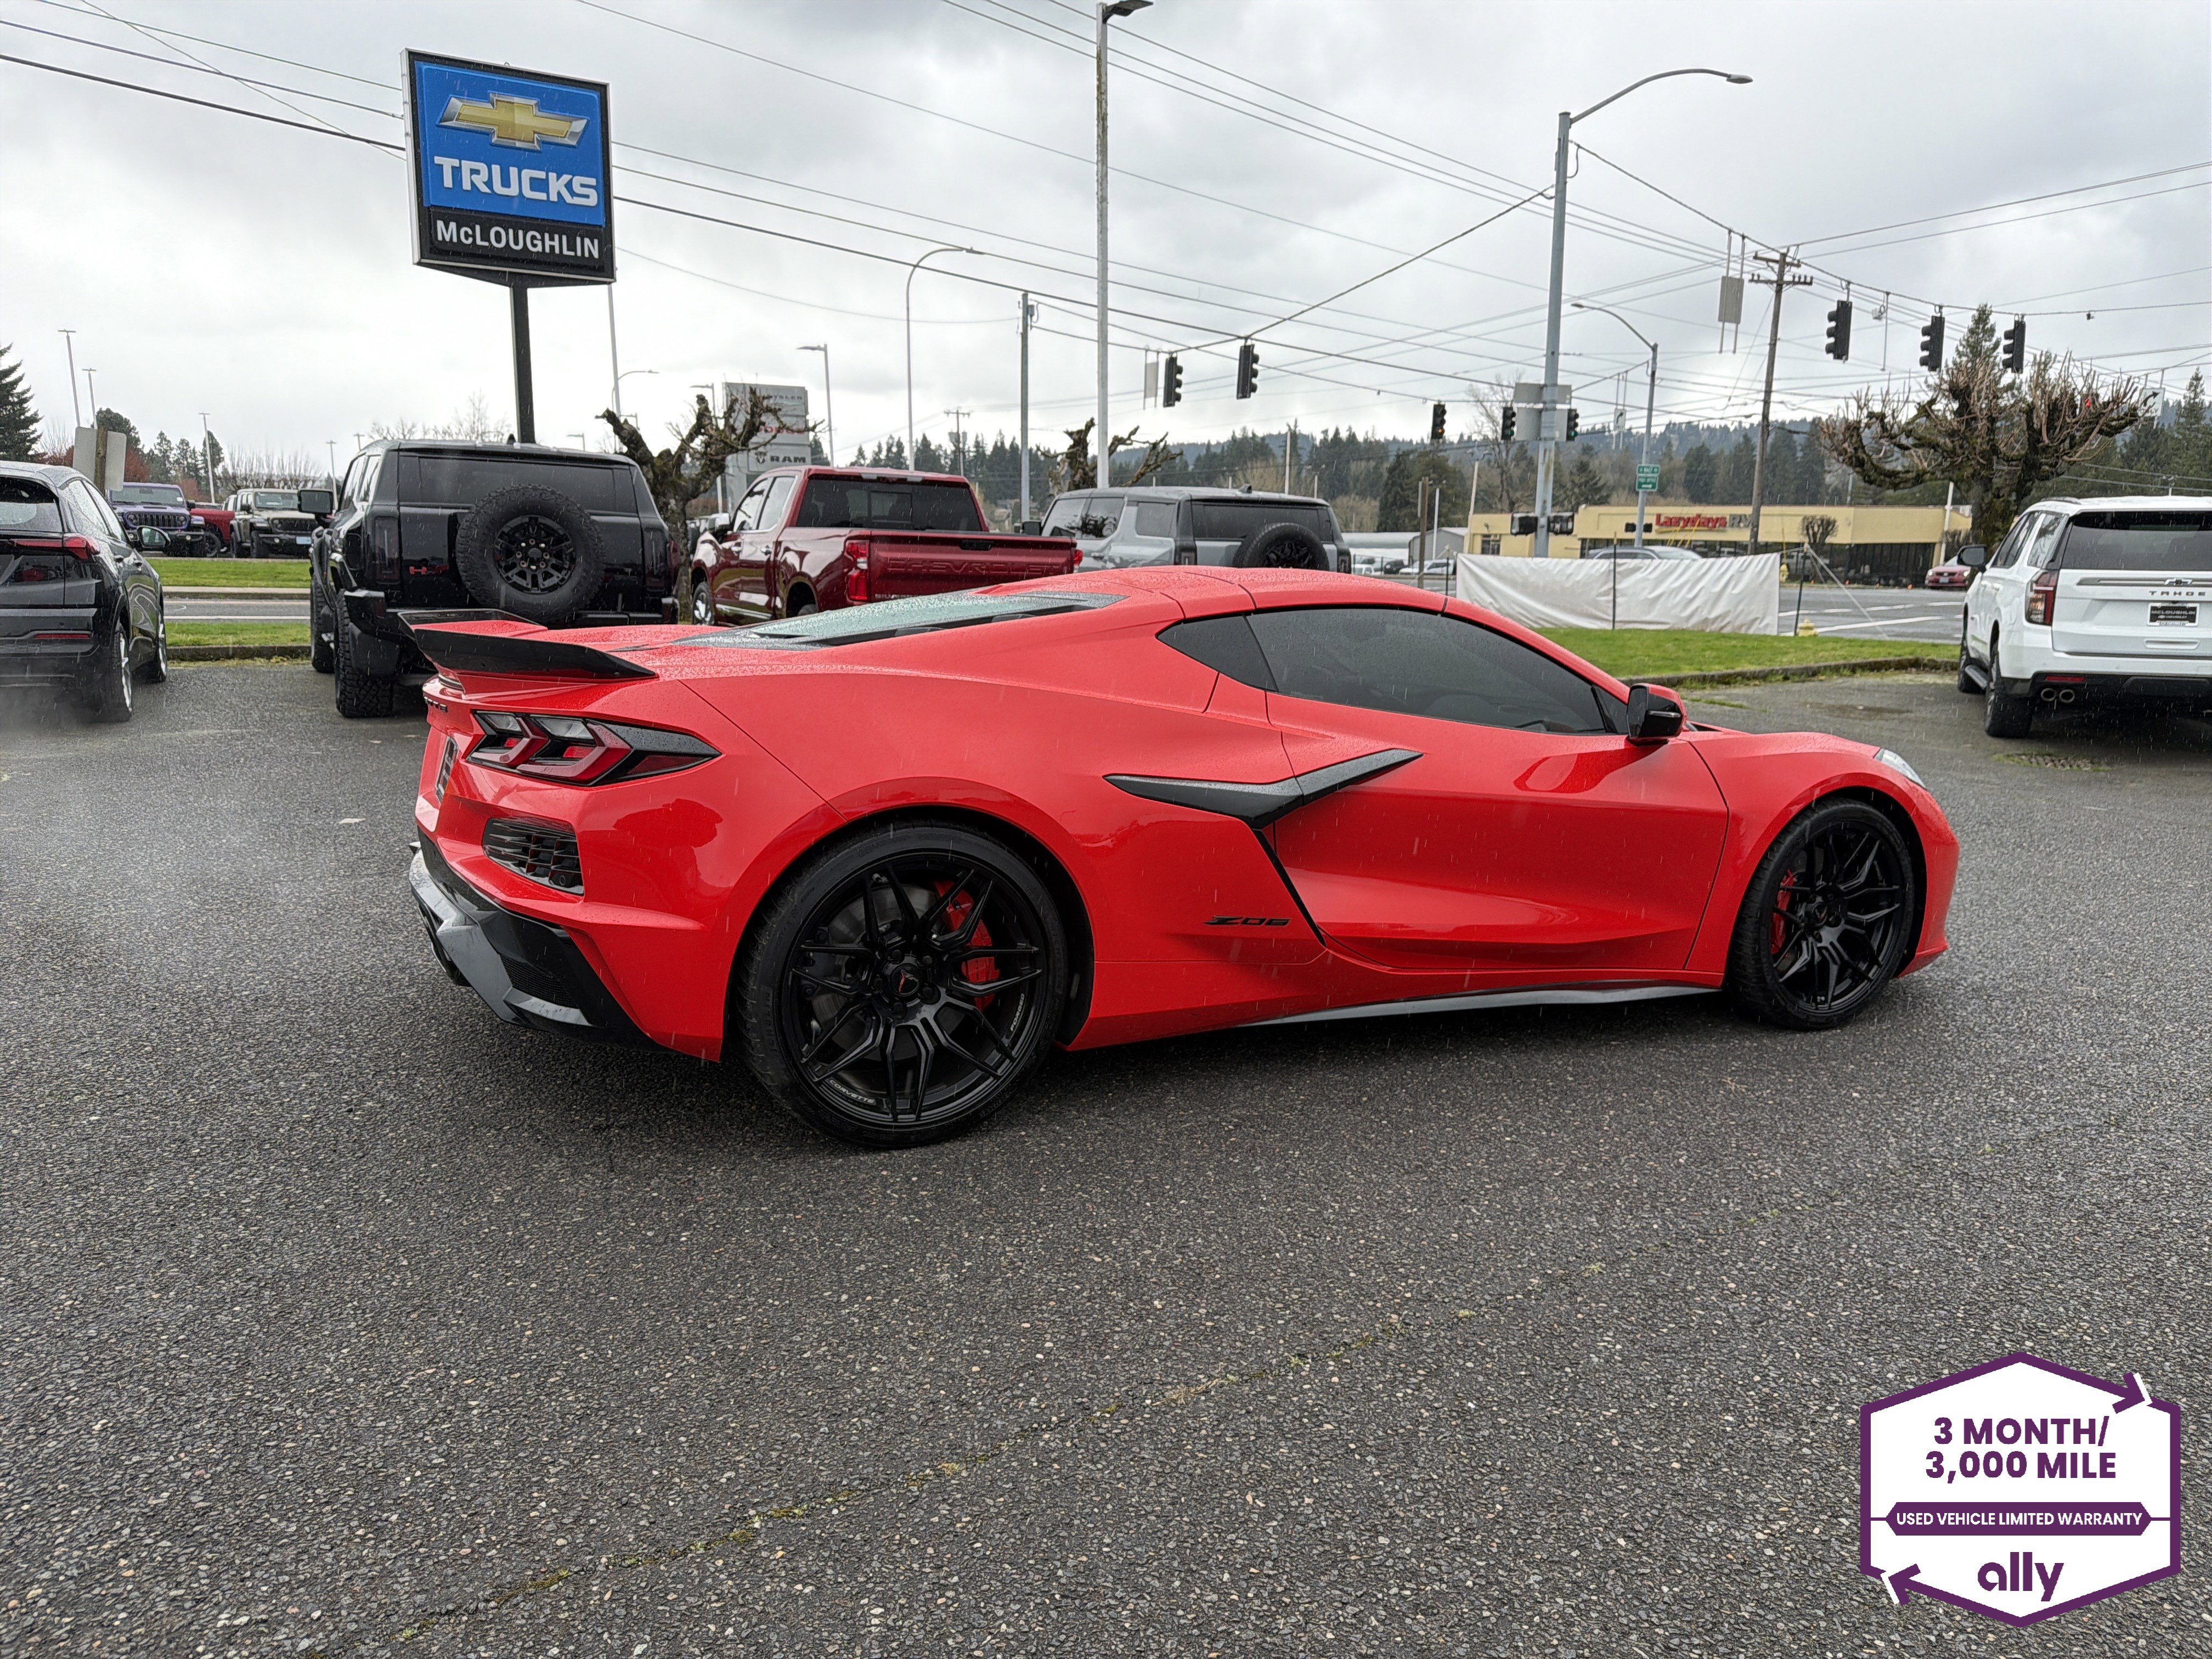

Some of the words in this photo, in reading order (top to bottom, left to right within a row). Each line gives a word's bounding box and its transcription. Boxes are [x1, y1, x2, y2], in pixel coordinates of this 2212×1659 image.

[434, 156, 598, 207] TRUCKS
[436, 219, 599, 259] McLOUGHLIN
[1656, 514, 1727, 530] Lazydays
[888, 560, 1060, 575] CHEVROLET
[1204, 915, 1291, 927] Z06
[1010, 993, 1025, 1031] FORGED
[829, 1079, 876, 1104] CORVETTE
